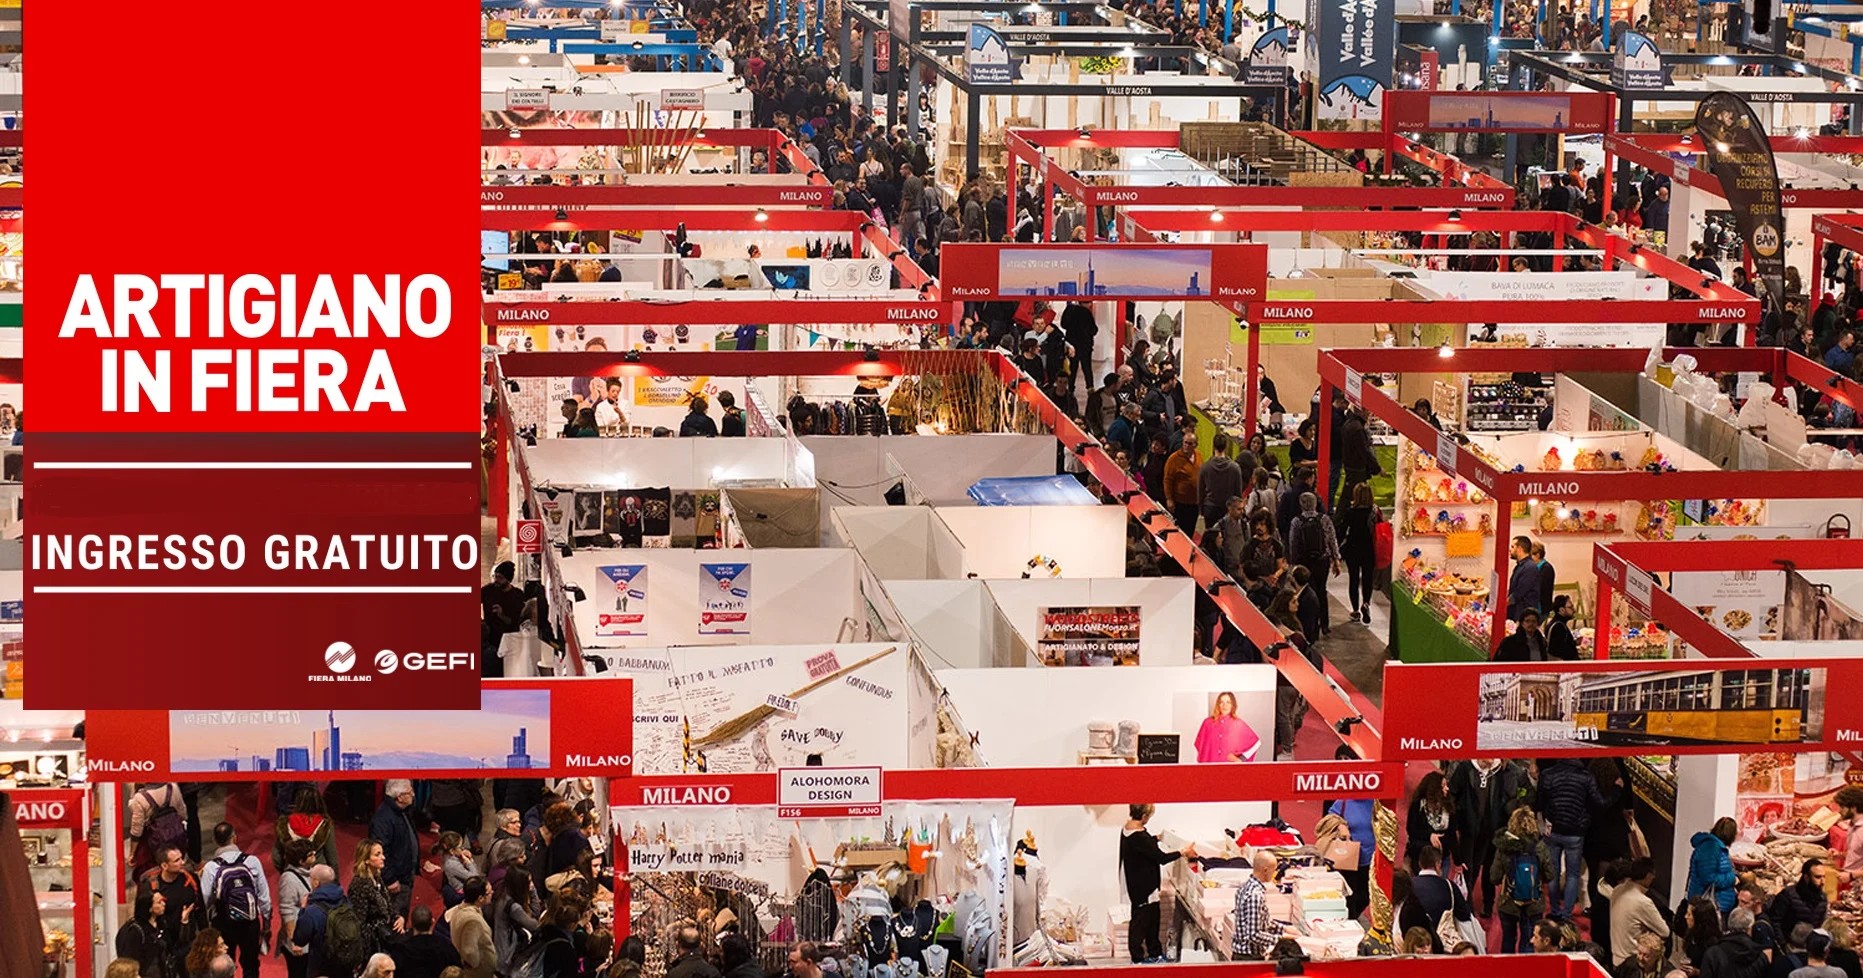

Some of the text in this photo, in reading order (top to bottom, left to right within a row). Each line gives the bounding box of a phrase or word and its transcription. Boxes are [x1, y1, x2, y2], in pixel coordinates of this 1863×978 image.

[1339, 23, 1357, 63] Valle
[1106, 86, 1152, 95] VALLE D'AOSTA
[1751, 93, 1793, 101] VALLE D'AOSTA
[780, 191, 823, 201] MILANO
[1096, 191, 1138, 201] MILANO
[1464, 193, 1505, 202] MILANO
[1755, 233, 1777, 247] BAM
[497, 309, 550, 320] MILANO
[887, 308, 938, 320] MILANO
[1263, 306, 1313, 318] MILANO
[1698, 308, 1746, 318] MILANO
[1518, 482, 1580, 496] MILANO
[1045, 643, 1098, 651] ARTIGIANATO
[1107, 643, 1138, 651] DESIGN
[806, 651, 834, 669] PROVA
[668, 672, 704, 688] FATTO
[662, 715, 679, 723] QUI
[781, 729, 811, 744] SAVE
[790, 776, 870, 787] ALOHOMORA
[1296, 772, 1380, 791] MILANO
[643, 786, 731, 805] MILANO
[808, 790, 852, 800] DESIGN
[780, 807, 880, 817] F156 MILANO
[632, 850, 744, 869] Harry Potter mania
